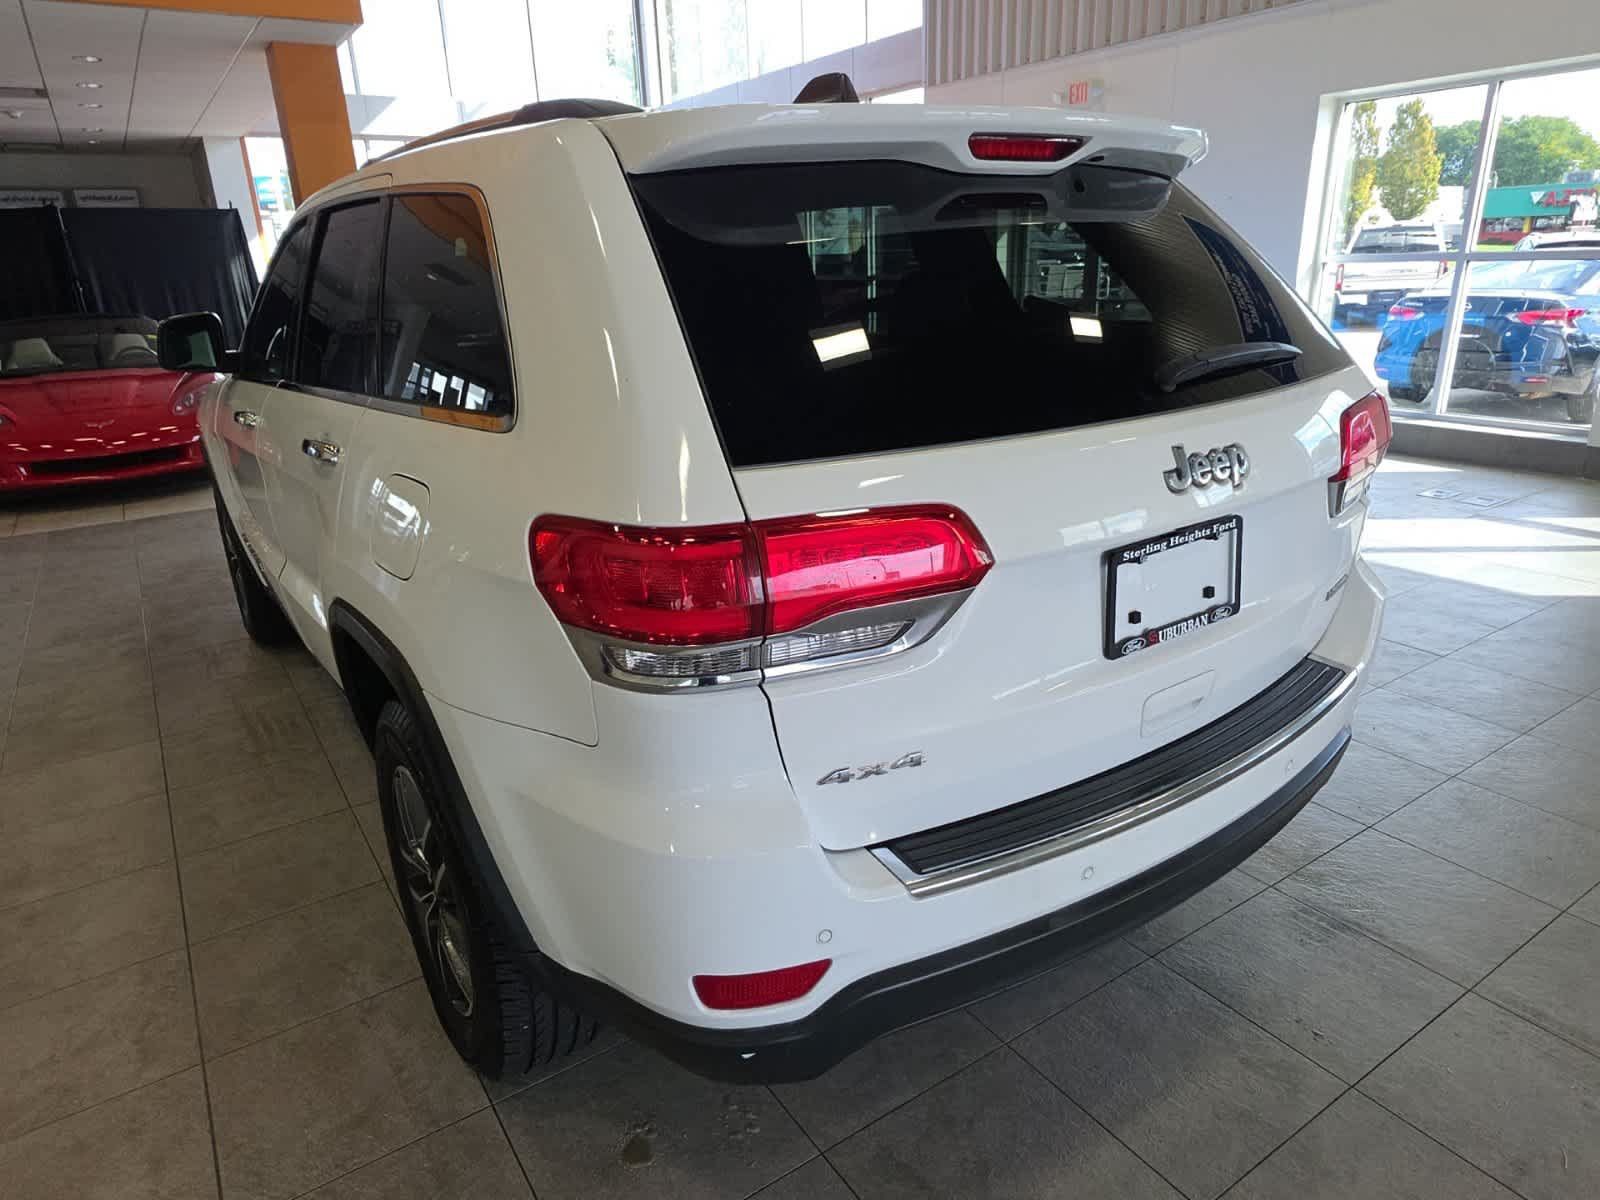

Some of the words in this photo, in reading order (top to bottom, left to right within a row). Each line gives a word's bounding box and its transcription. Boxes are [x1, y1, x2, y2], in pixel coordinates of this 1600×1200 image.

[1068, 83, 1089, 105] EXIT
[1163, 443, 1250, 493] Jeep
[1122, 541, 1168, 561] Sterling
[1169, 526, 1211, 547] Heights
[1212, 518, 1238, 534] Ford
[1147, 613, 1210, 647] SUBURBAN
